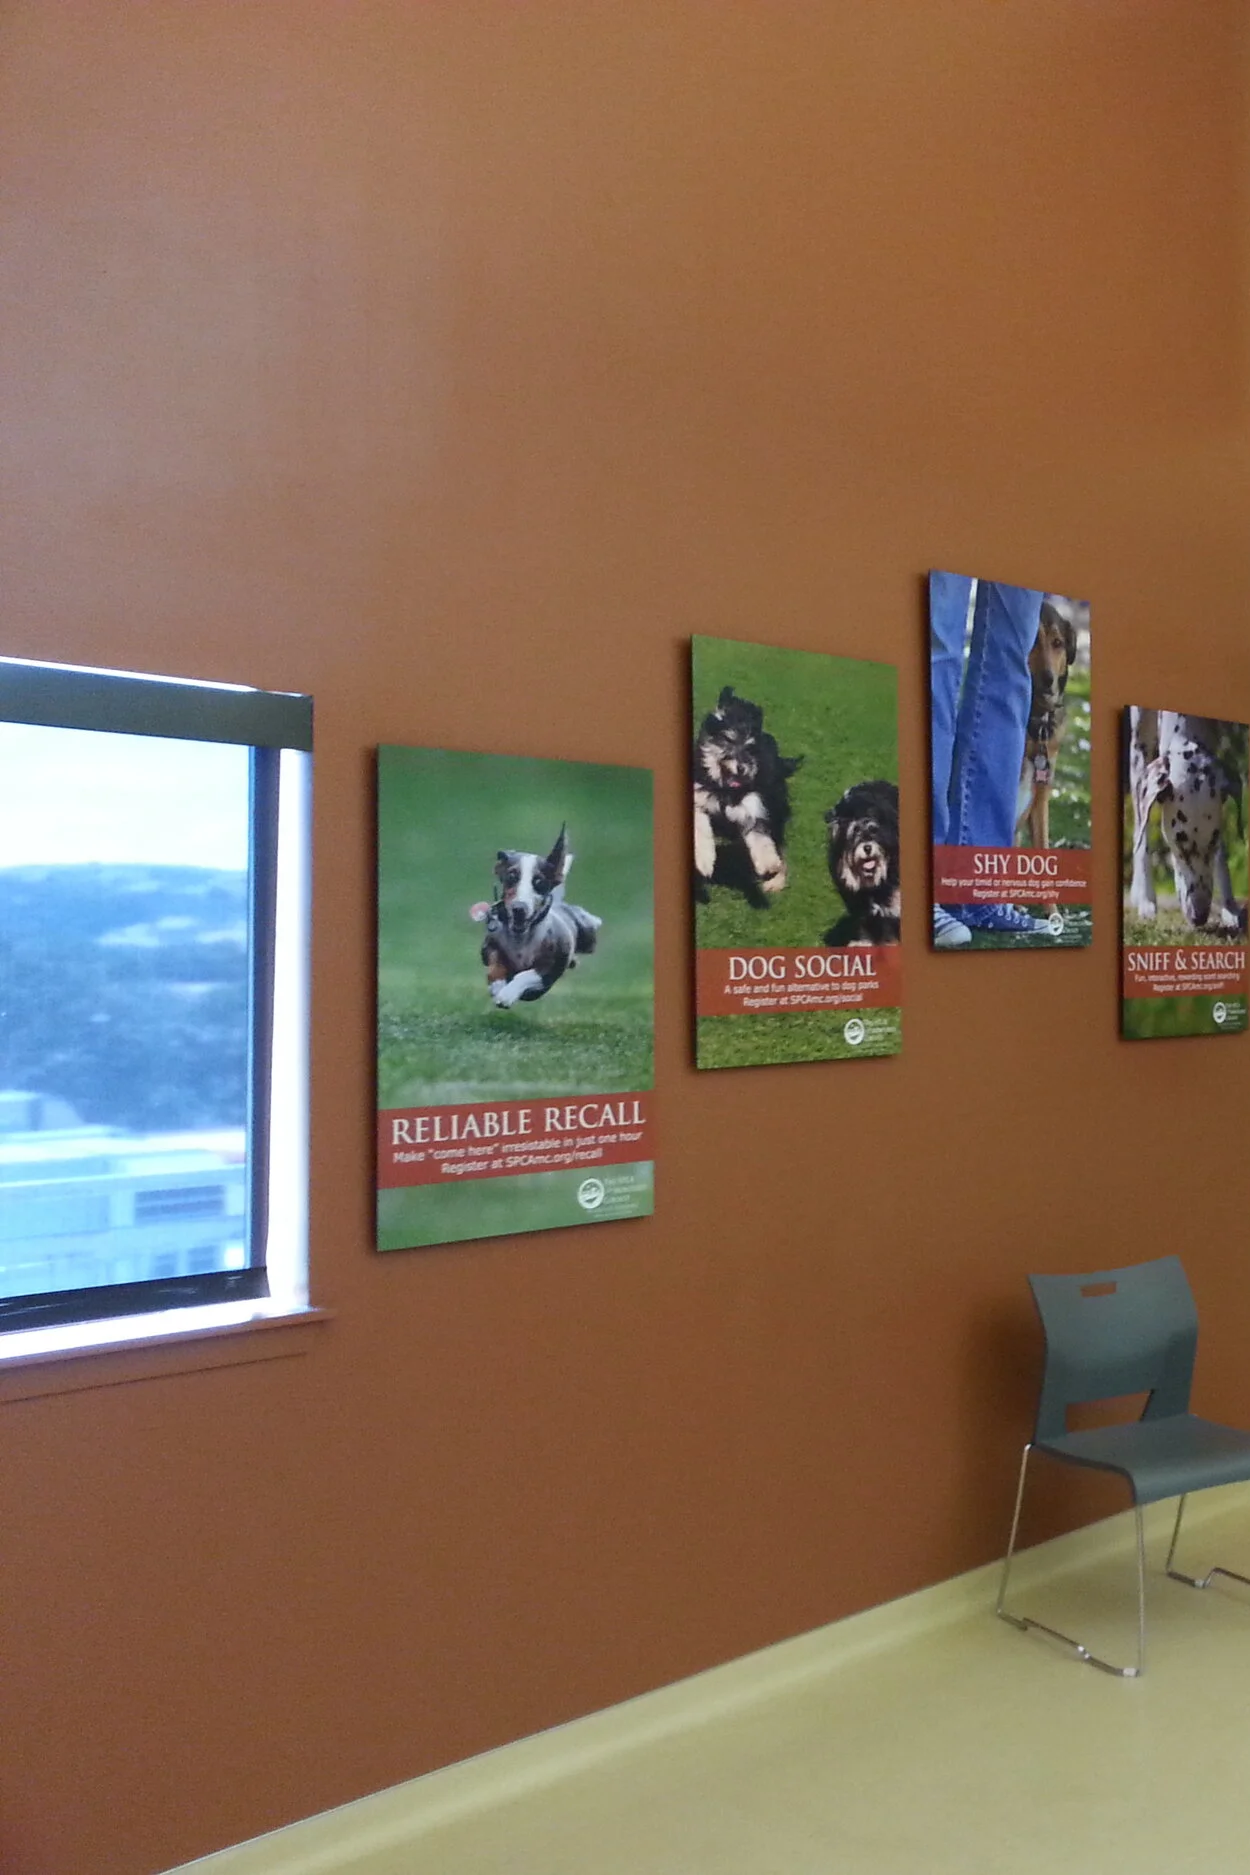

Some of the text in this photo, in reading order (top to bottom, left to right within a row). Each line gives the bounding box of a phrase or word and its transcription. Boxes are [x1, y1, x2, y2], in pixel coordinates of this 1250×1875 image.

[974, 853, 1058, 876] SHY DOG
[973, 889, 1000, 900] Register
[1028, 879, 1040, 888] dog
[729, 954, 877, 981] DOG SOCIAL
[1128, 949, 1245, 971] SNIFF & SEARCH
[724, 979, 879, 995] A safe and fun alternative to dog parks
[743, 996, 778, 1008] Register
[779, 996, 789, 1006] at
[391, 1100, 646, 1146] RELIABLE RECALL
[393, 1150, 425, 1164] Make
[563, 1137, 574, 1148] in
[575, 1135, 596, 1149] just
[597, 1133, 617, 1144] one
[619, 1131, 643, 1142] hour
[441, 1147, 603, 1175] Register at SPCAmc.org/recall
